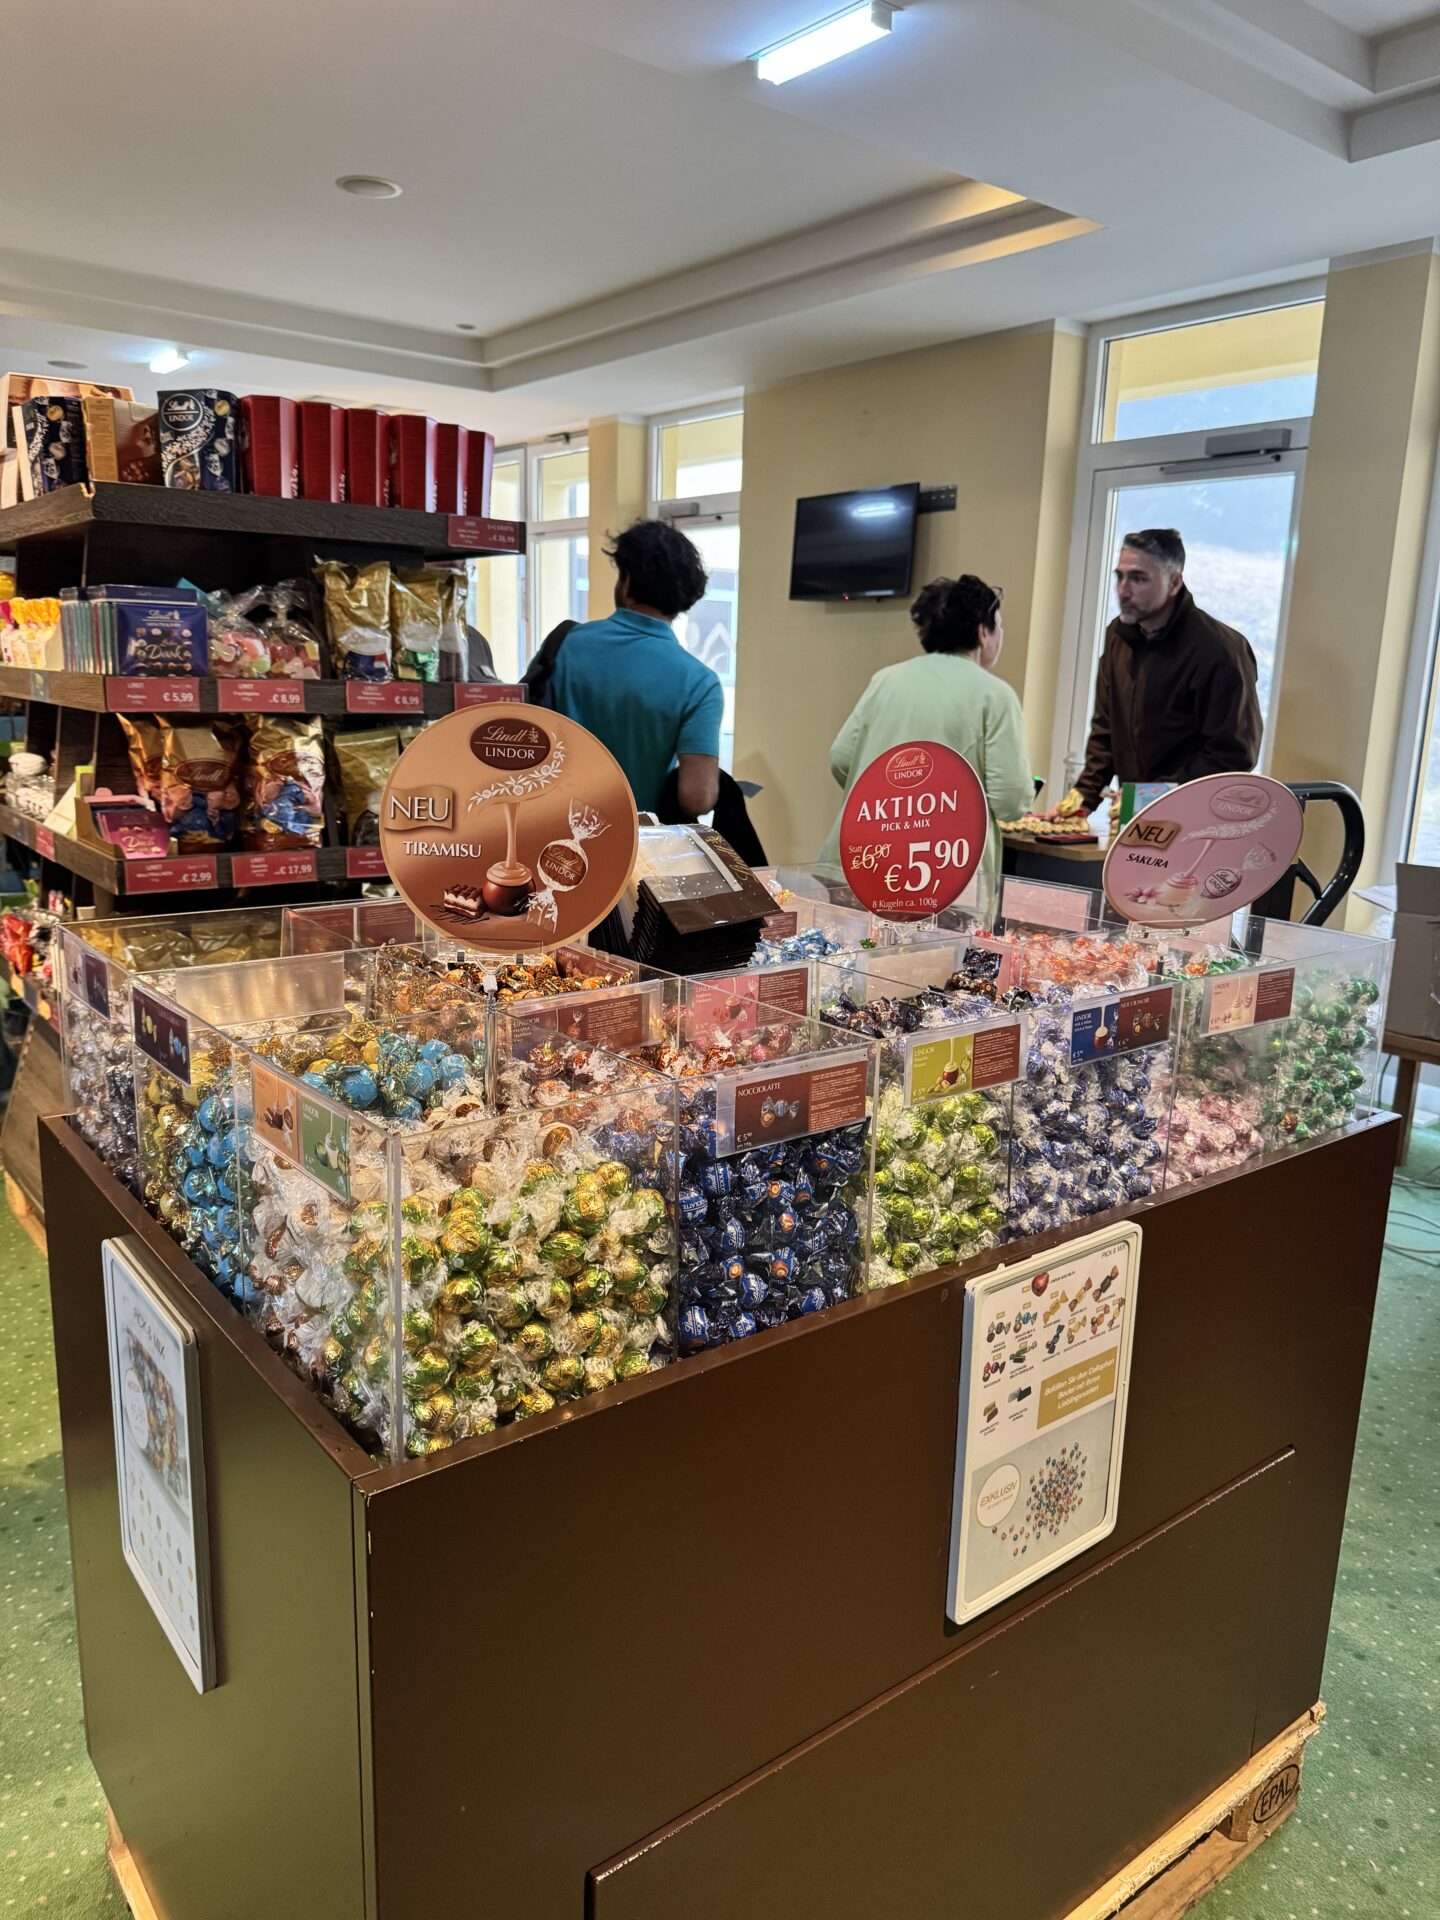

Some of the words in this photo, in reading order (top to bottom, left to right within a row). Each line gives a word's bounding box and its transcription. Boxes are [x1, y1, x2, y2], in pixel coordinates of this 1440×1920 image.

[145, 643, 184, 661] Dark
[163, 692, 171, 702] €
[172, 692, 194, 703] 5,99
[272, 694, 279, 703] €
[281, 694, 300, 704] 8,99
[394, 696, 401, 704] €
[482, 725, 528, 743] Lindt
[485, 746, 536, 760] LINDOR
[894, 769, 923, 780] LINDOR
[389, 796, 449, 821] NEU
[857, 790, 957, 822] AKTION
[1218, 803, 1254, 816] LINDOR
[881, 821, 901, 832] PICK
[903, 821, 910, 830] &
[913, 819, 931, 829] MIX
[1128, 823, 1175, 844] NEU
[402, 841, 482, 859] TIRAMISU
[848, 845, 863, 853] Statt
[1126, 853, 1169, 869] SAKURA
[280, 866, 286, 875] €
[545, 860, 576, 881] LINDOR
[182, 874, 189, 882] €
[879, 900, 904, 910] Kugeln
[919, 898, 937, 908] 100g
[1074, 1013, 1092, 1022] LINDOR
[914, 1046, 936, 1056] LINDOR
[738, 1082, 782, 1097] NOCCIOLATTE
[1068, 1376, 1077, 1385] Sie
[980, 1480, 1017, 1507] EXKLUSIV
[1260, 1773, 1292, 1817] EPAL
